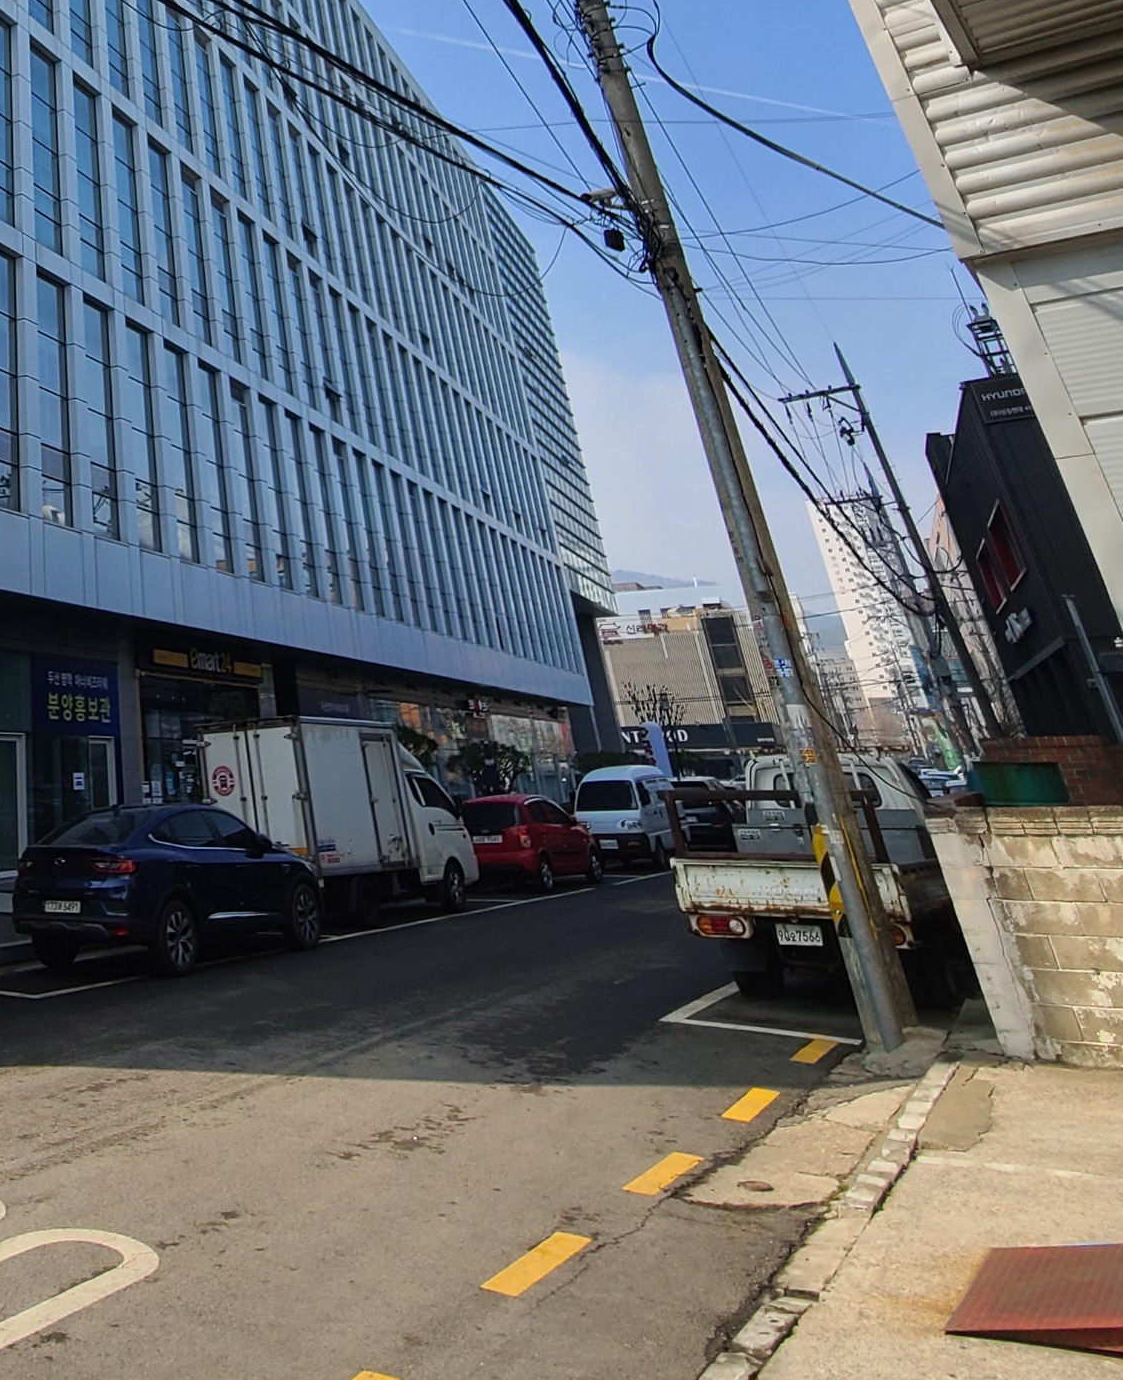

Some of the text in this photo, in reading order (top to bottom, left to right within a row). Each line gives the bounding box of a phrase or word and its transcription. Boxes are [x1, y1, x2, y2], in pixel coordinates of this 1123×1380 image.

[190, 648, 232, 673] emart24
[47, 671, 60, 686] 두산
[47, 692, 111, 723] 분양홍보관
